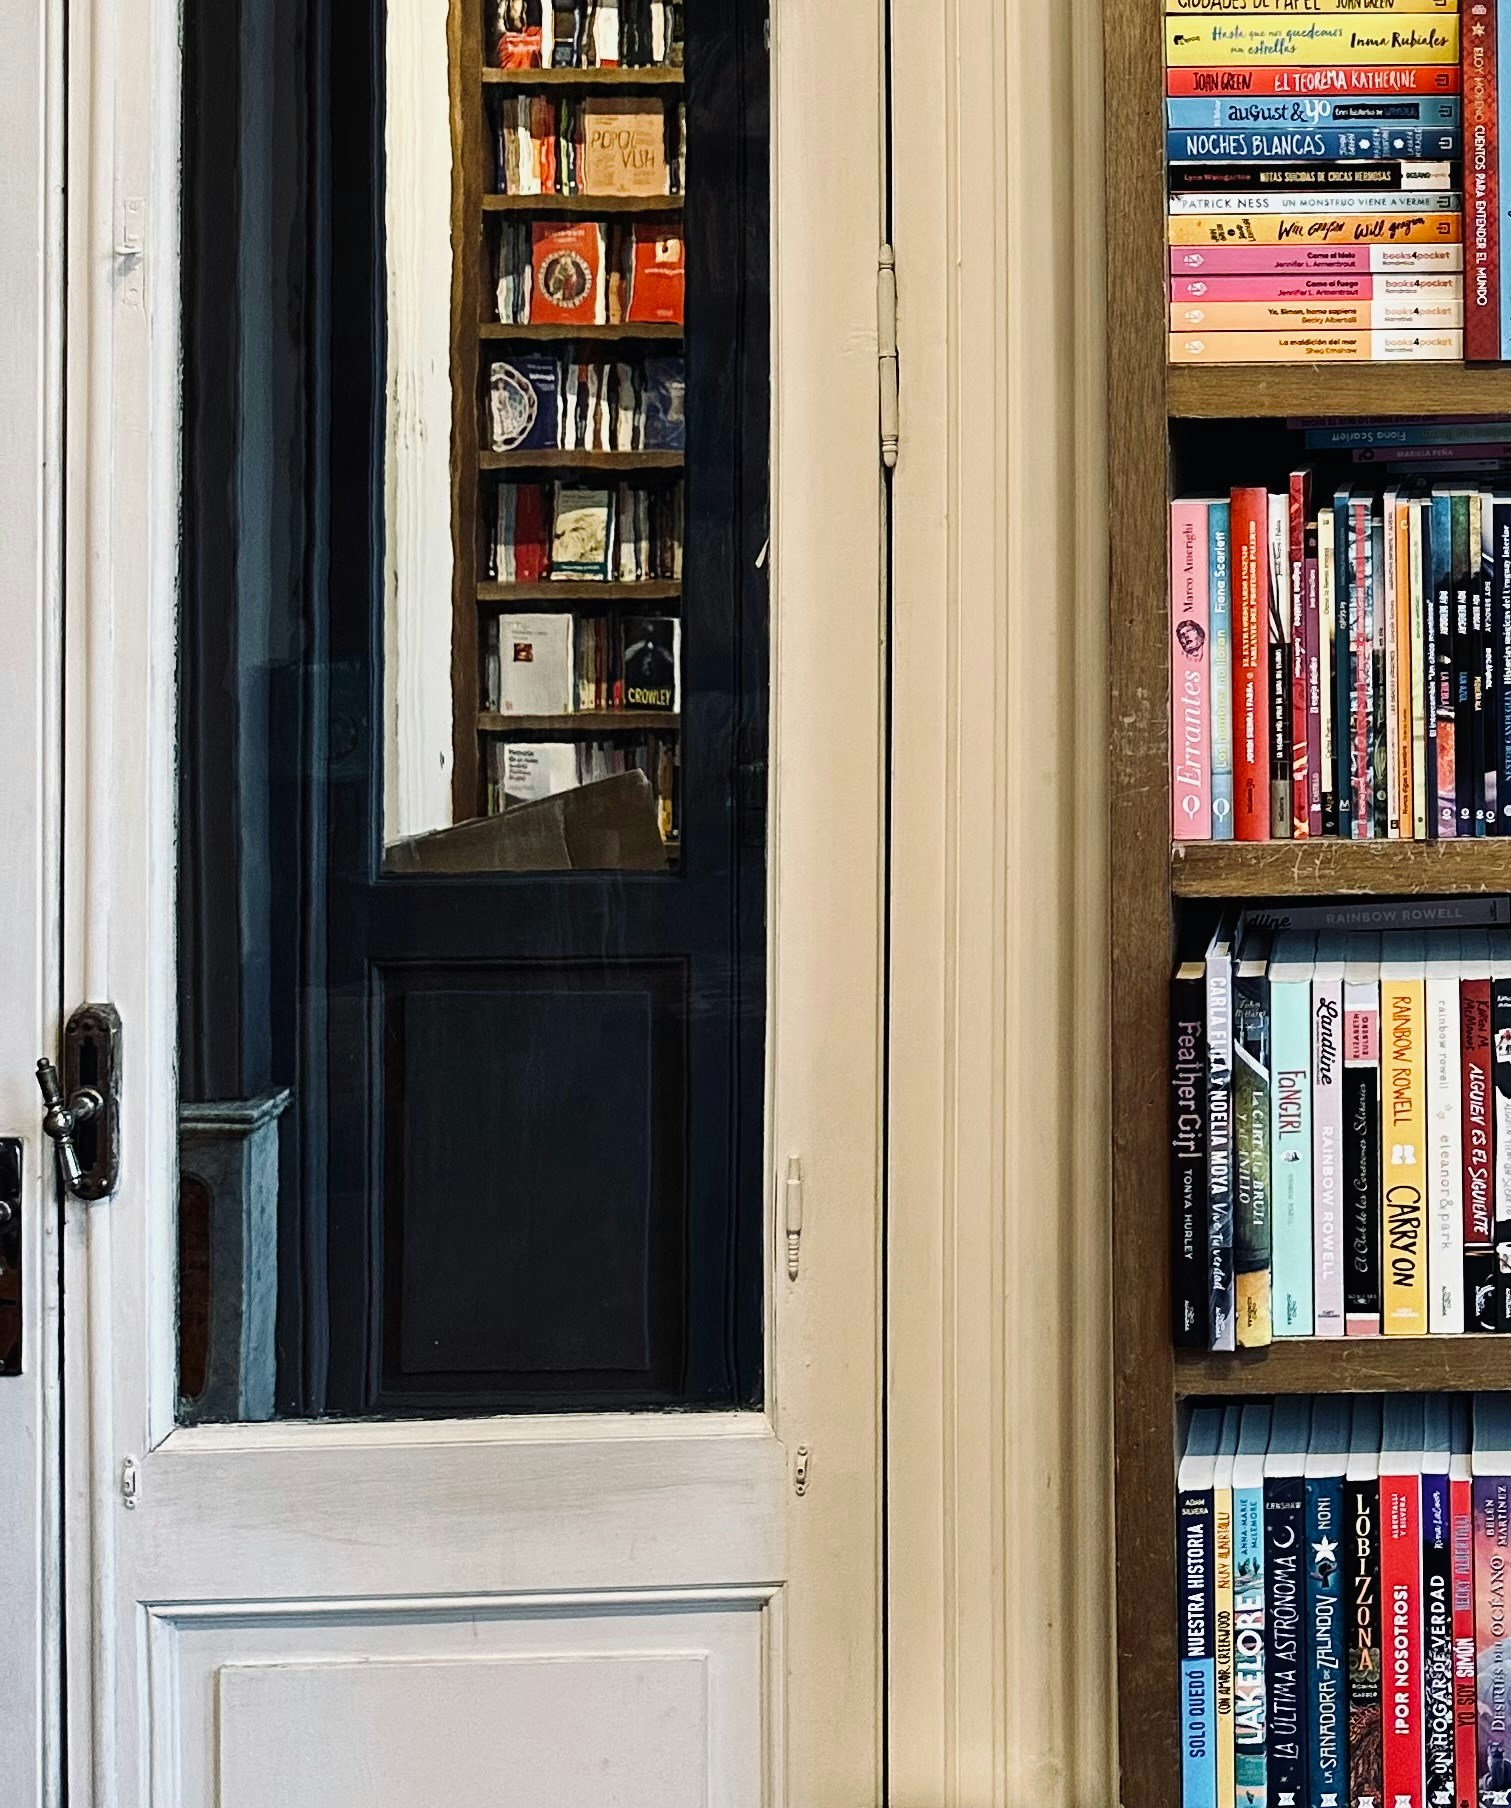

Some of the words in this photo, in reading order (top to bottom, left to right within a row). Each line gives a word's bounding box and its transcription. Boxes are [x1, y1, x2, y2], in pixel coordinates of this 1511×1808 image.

[1350, 31, 1387, 49] Inma
[1390, 29, 1448, 49] Rubiales
[590, 129, 636, 151] POPOL
[1186, 136, 1248, 157] NOCHES
[1252, 134, 1325, 156] BLANCAS
[1182, 197, 1231, 210] PATRICK
[1238, 196, 1270, 209] NESS
[1282, 196, 1297, 206] UN
[1300, 196, 1353, 206] MONSTRUO
[1358, 195, 1387, 206] VIENE
[1389, 195, 1398, 205] A
[1399, 195, 1431, 205] VERME
[1383, 250, 1450, 263] books4pocket
[1183, 523, 1195, 574] Amerighi
[1184, 574, 1195, 614] Marco
[627, 688, 670, 706] CROWLEY
[1177, 669, 1200, 787] Errantes
[1318, 997, 1339, 1086] Landline
[1392, 995, 1411, 1060] RAINBOW
[1393, 1063, 1414, 1128] ROWELL
[1386, 1185, 1421, 1255] CARRY
[1392, 1258, 1415, 1289] ON
[1186, 1524, 1204, 1589] HISTORIA
[1355, 1493, 1373, 1671] LOBIZONA
[1188, 1592, 1204, 1657] NUESTRA
[1188, 1669, 1206, 1718] QUEDÓ
[1236, 1595, 1263, 1745] LAKELORE
[1189, 1721, 1206, 1759] SOLO
